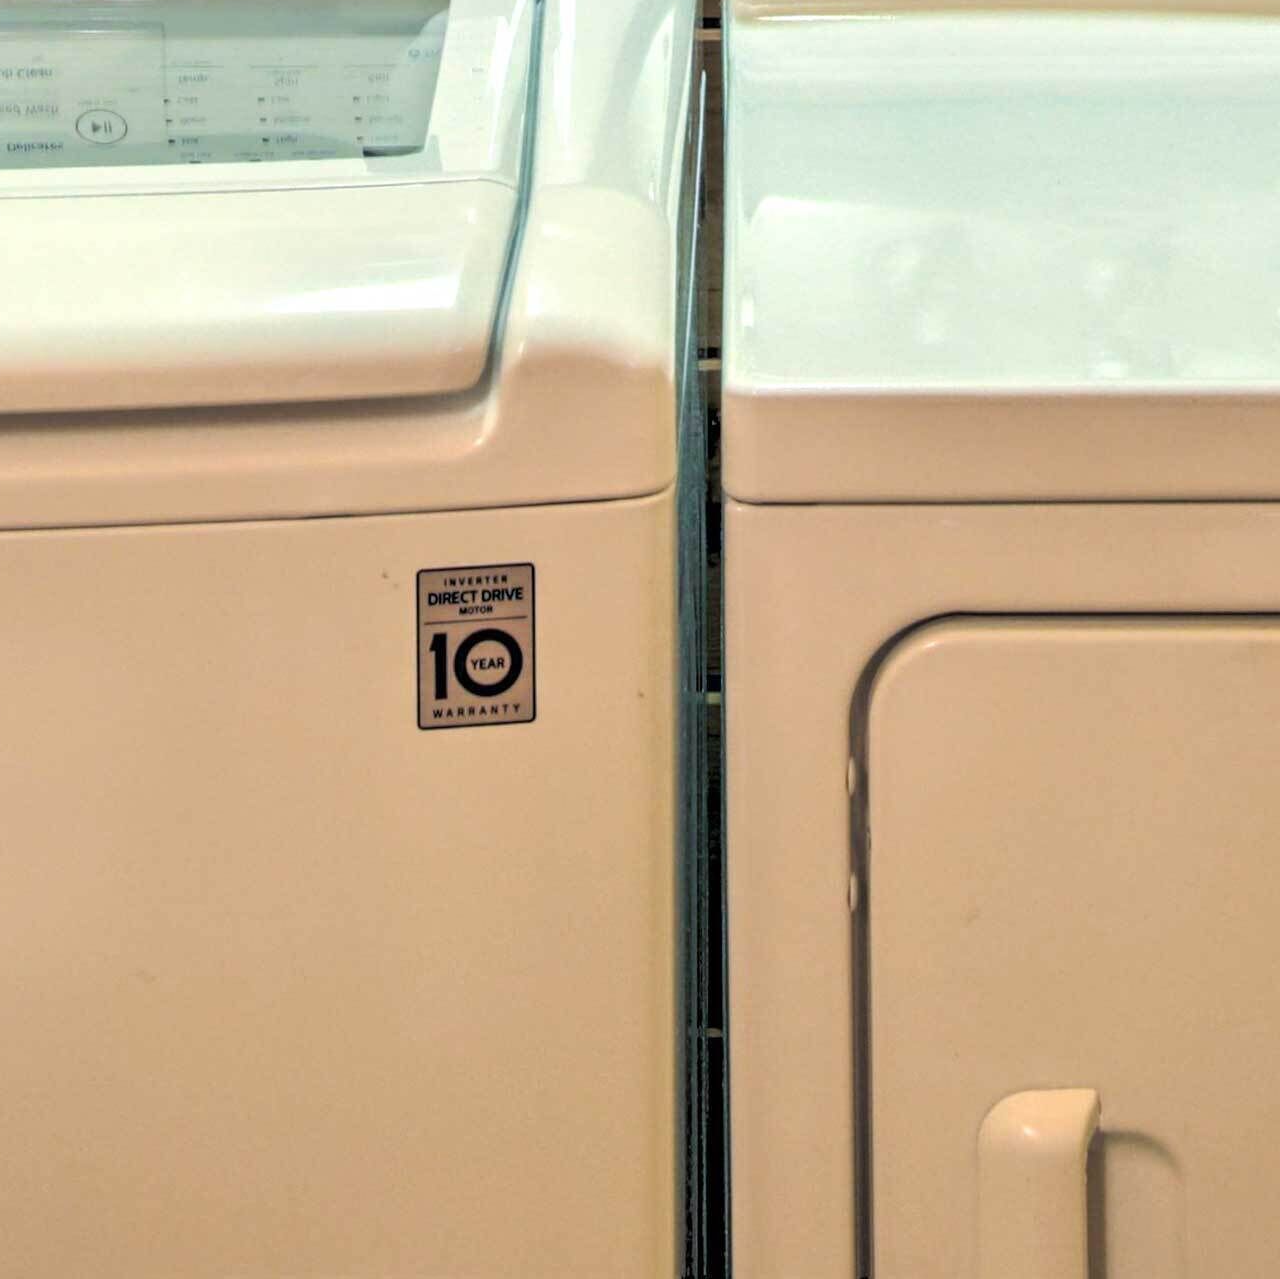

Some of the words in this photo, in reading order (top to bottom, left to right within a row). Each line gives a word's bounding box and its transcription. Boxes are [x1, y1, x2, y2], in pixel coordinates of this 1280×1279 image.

[443, 575, 508, 587] INVERTER
[427, 590, 479, 606] DIRECT
[481, 587, 524, 602] DRIVE
[458, 605, 494, 616] MOTOR
[429, 628, 524, 700] 10
[470, 657, 505, 671] YEAR
[433, 703, 521, 719] WARRANTY
